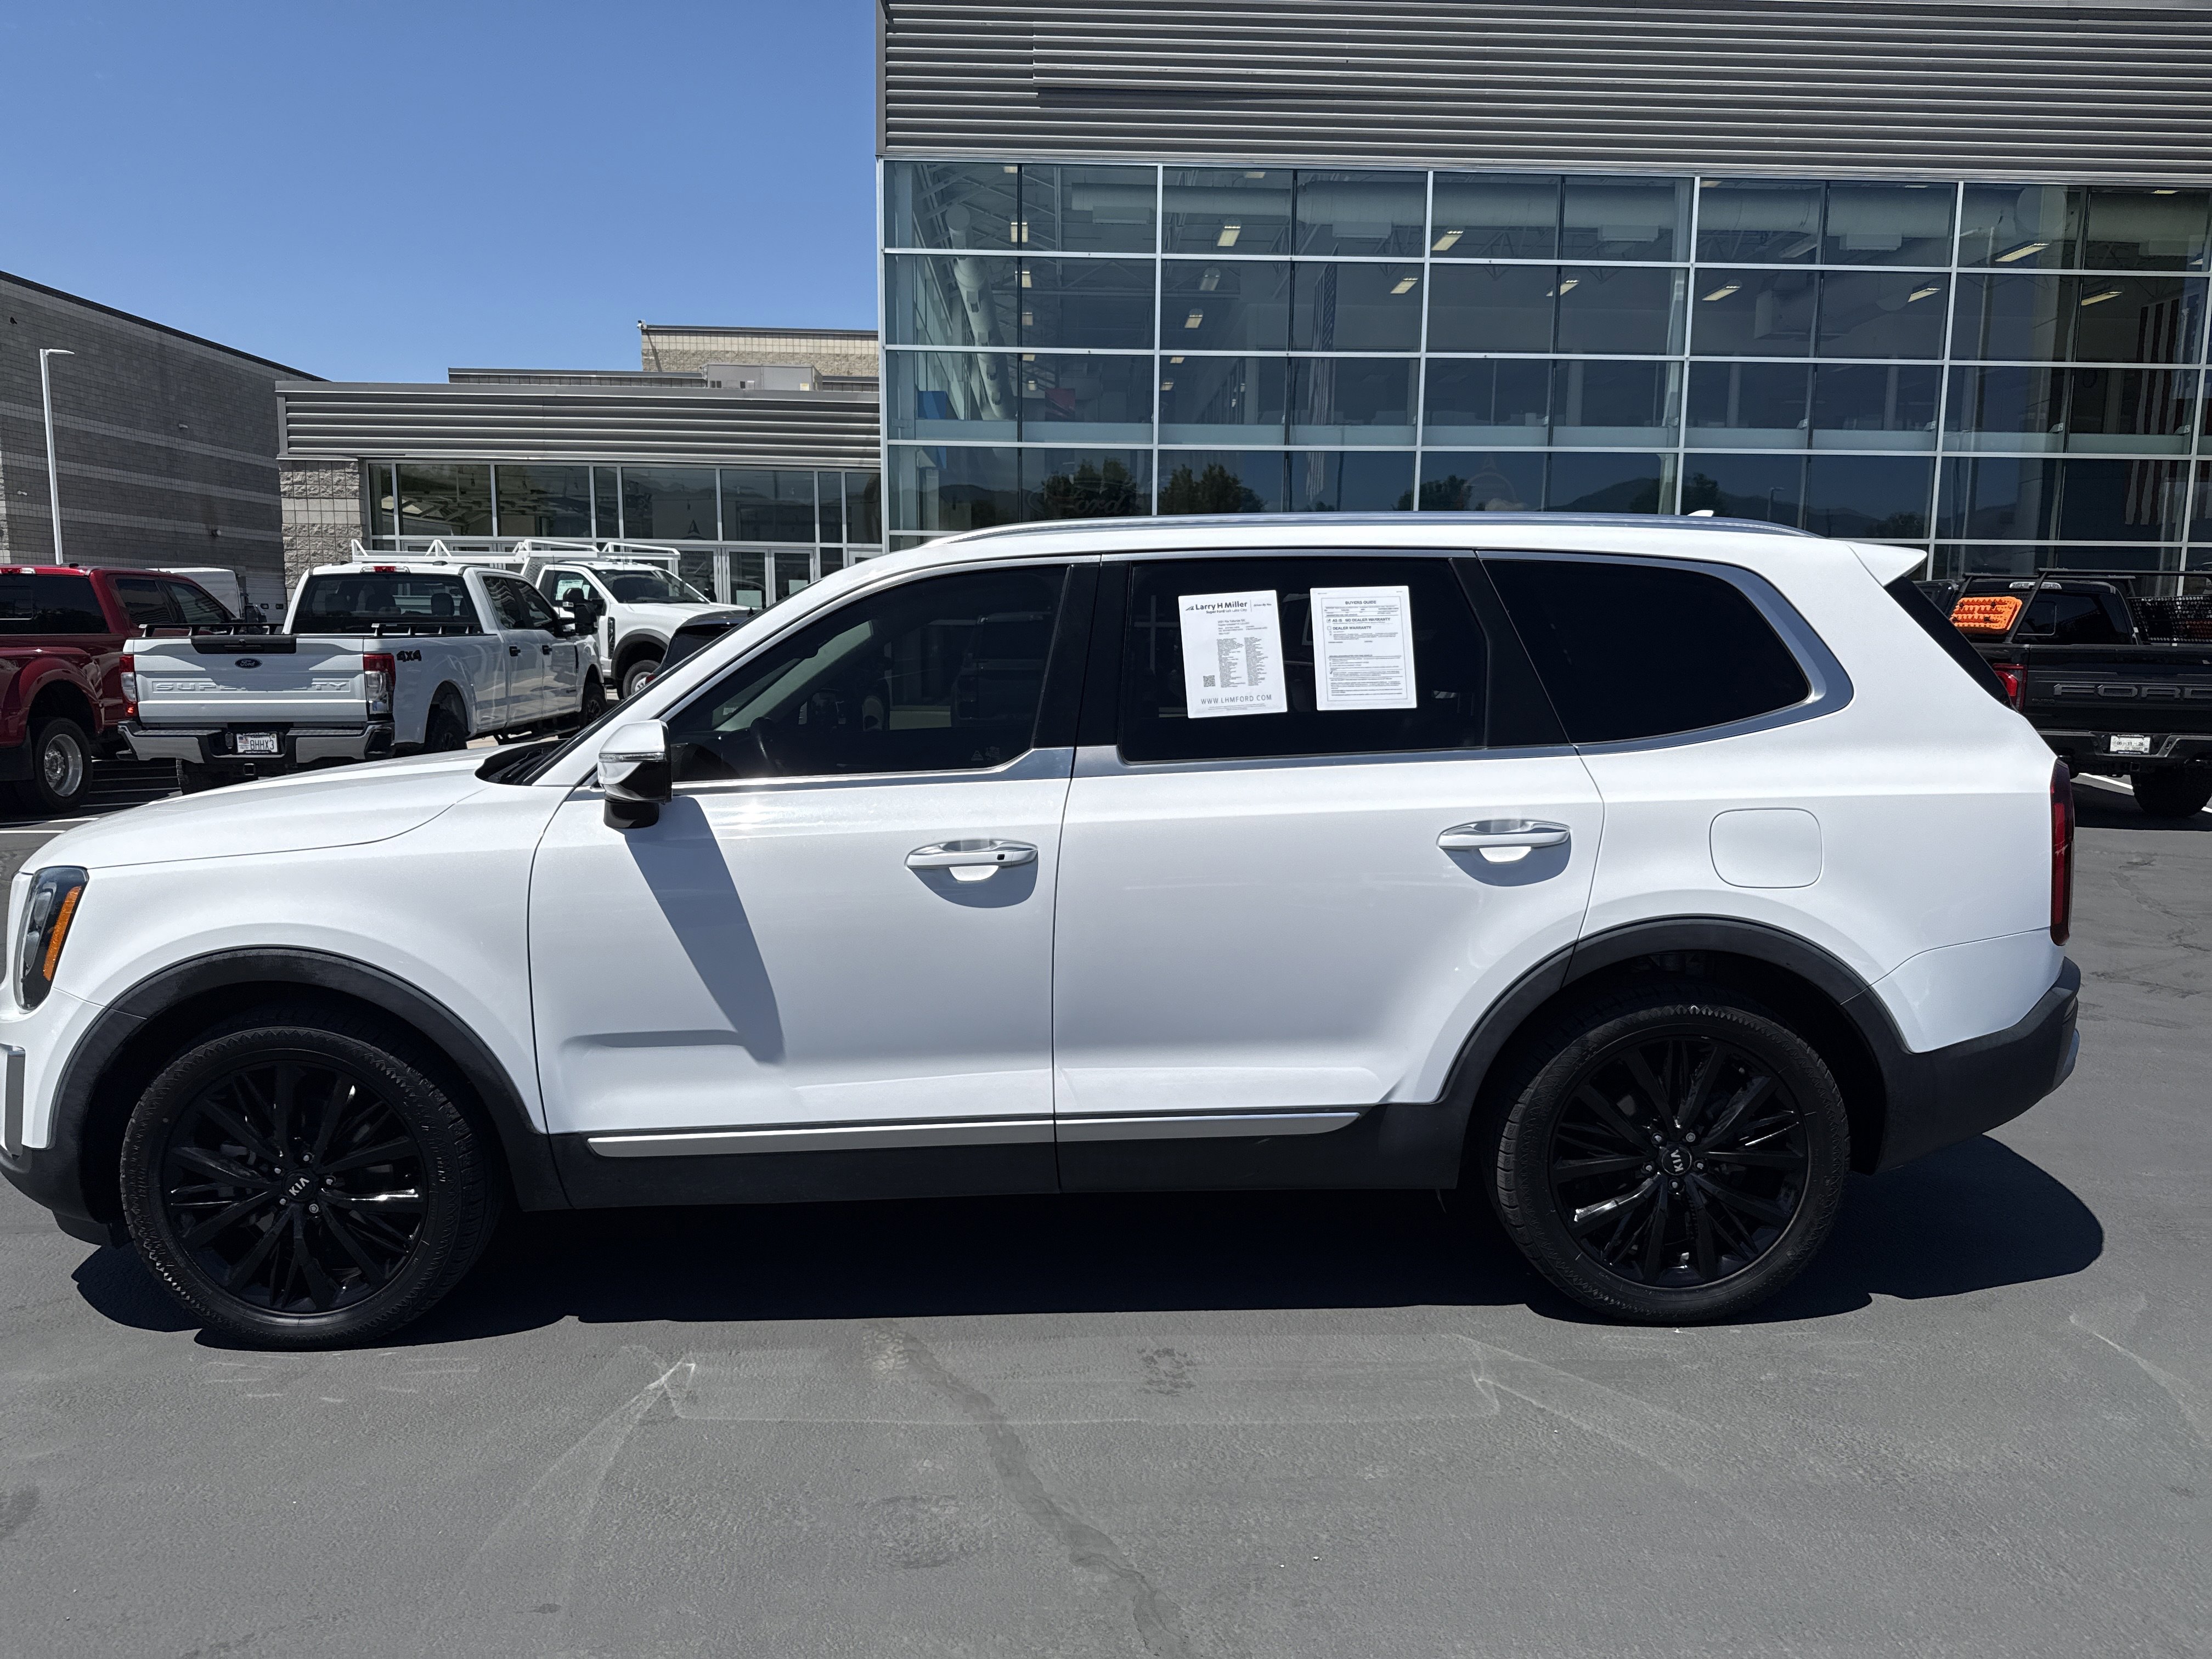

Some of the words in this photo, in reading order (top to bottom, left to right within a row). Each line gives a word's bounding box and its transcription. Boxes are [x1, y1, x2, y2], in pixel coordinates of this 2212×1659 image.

[156, 682, 248, 691] SUPE
[250, 740, 274, 750] 8HHX3
[1671, 1149, 1684, 1172] KIA
[289, 1177, 310, 1196] KIA
